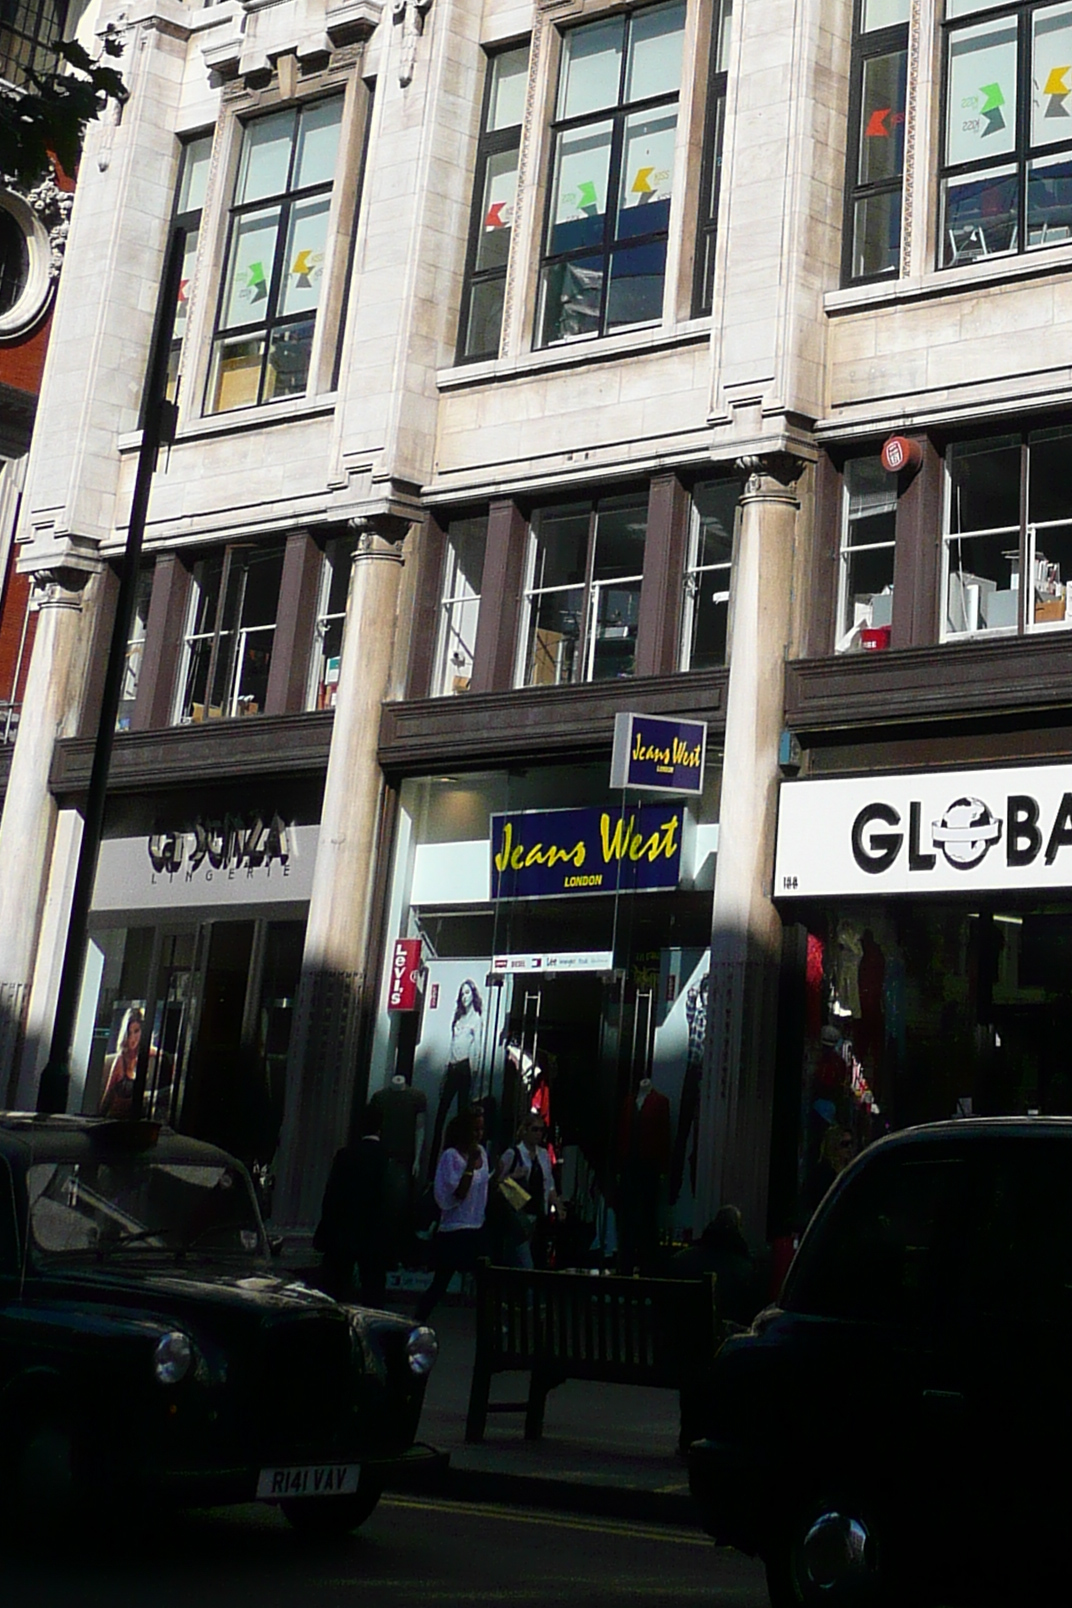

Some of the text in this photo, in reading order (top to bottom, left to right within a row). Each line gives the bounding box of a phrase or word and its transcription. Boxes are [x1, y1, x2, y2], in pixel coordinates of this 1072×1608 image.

[632, 733, 701, 768] Jeans West
[494, 813, 679, 872] Jeans West
[151, 864, 290, 884] LINGERIE
[564, 874, 602, 888] LONDON
[272, 1470, 308, 1493] R141
